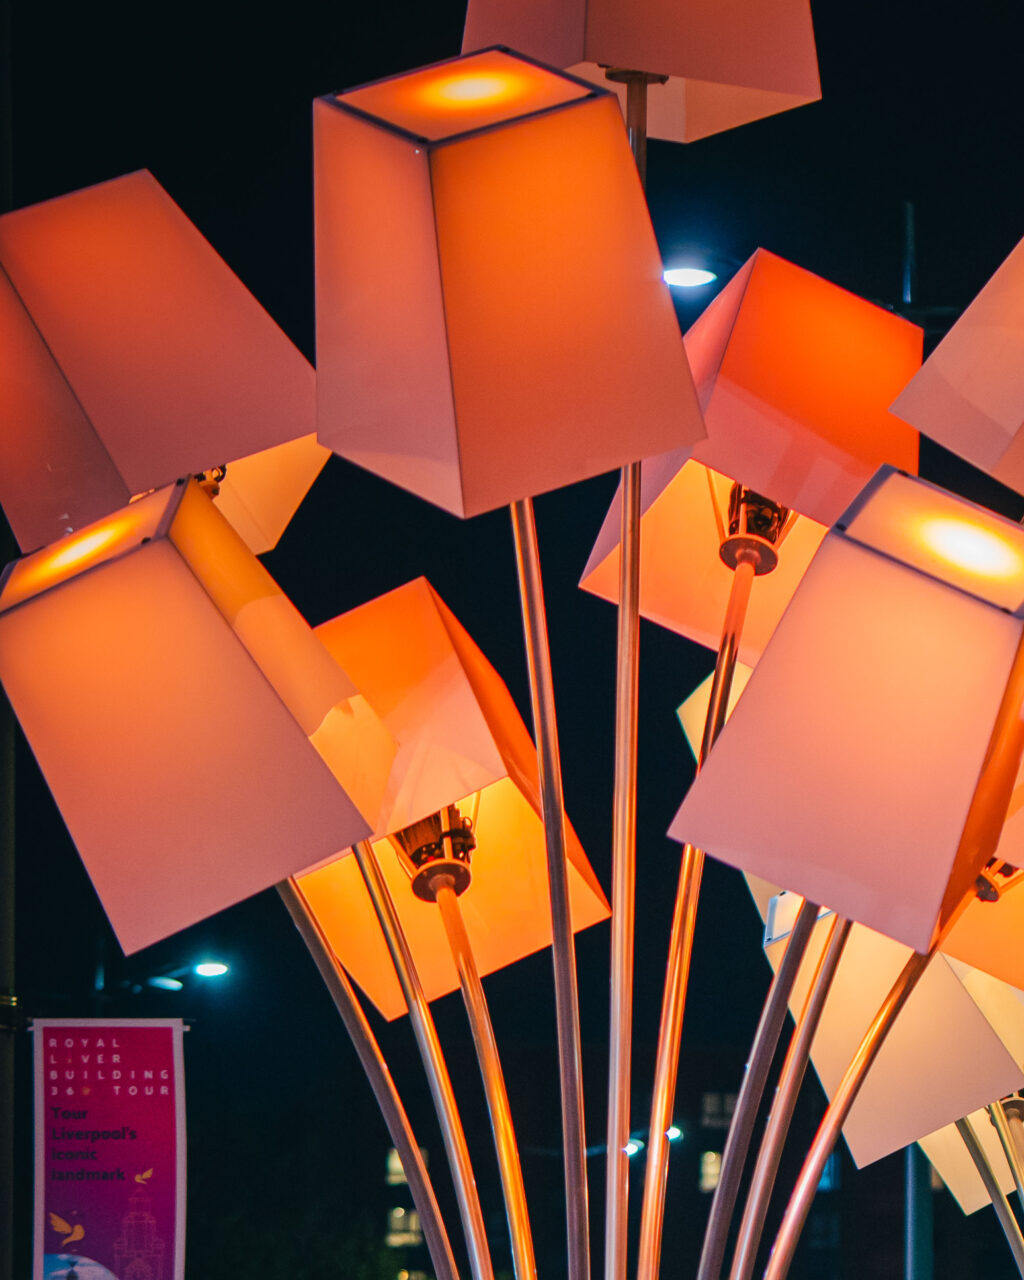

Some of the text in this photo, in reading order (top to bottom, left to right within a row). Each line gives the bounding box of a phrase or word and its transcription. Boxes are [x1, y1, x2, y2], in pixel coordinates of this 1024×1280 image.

[48, 1038, 120, 1048] ROYAL
[49, 1069, 169, 1080] BUILDING
[113, 1085, 169, 1096] TOUR
[50, 1106, 88, 1119] Tour
[51, 1126, 137, 1142] Liverpool's
[51, 1147, 98, 1160] iconic
[51, 1168, 125, 1181] landmark
